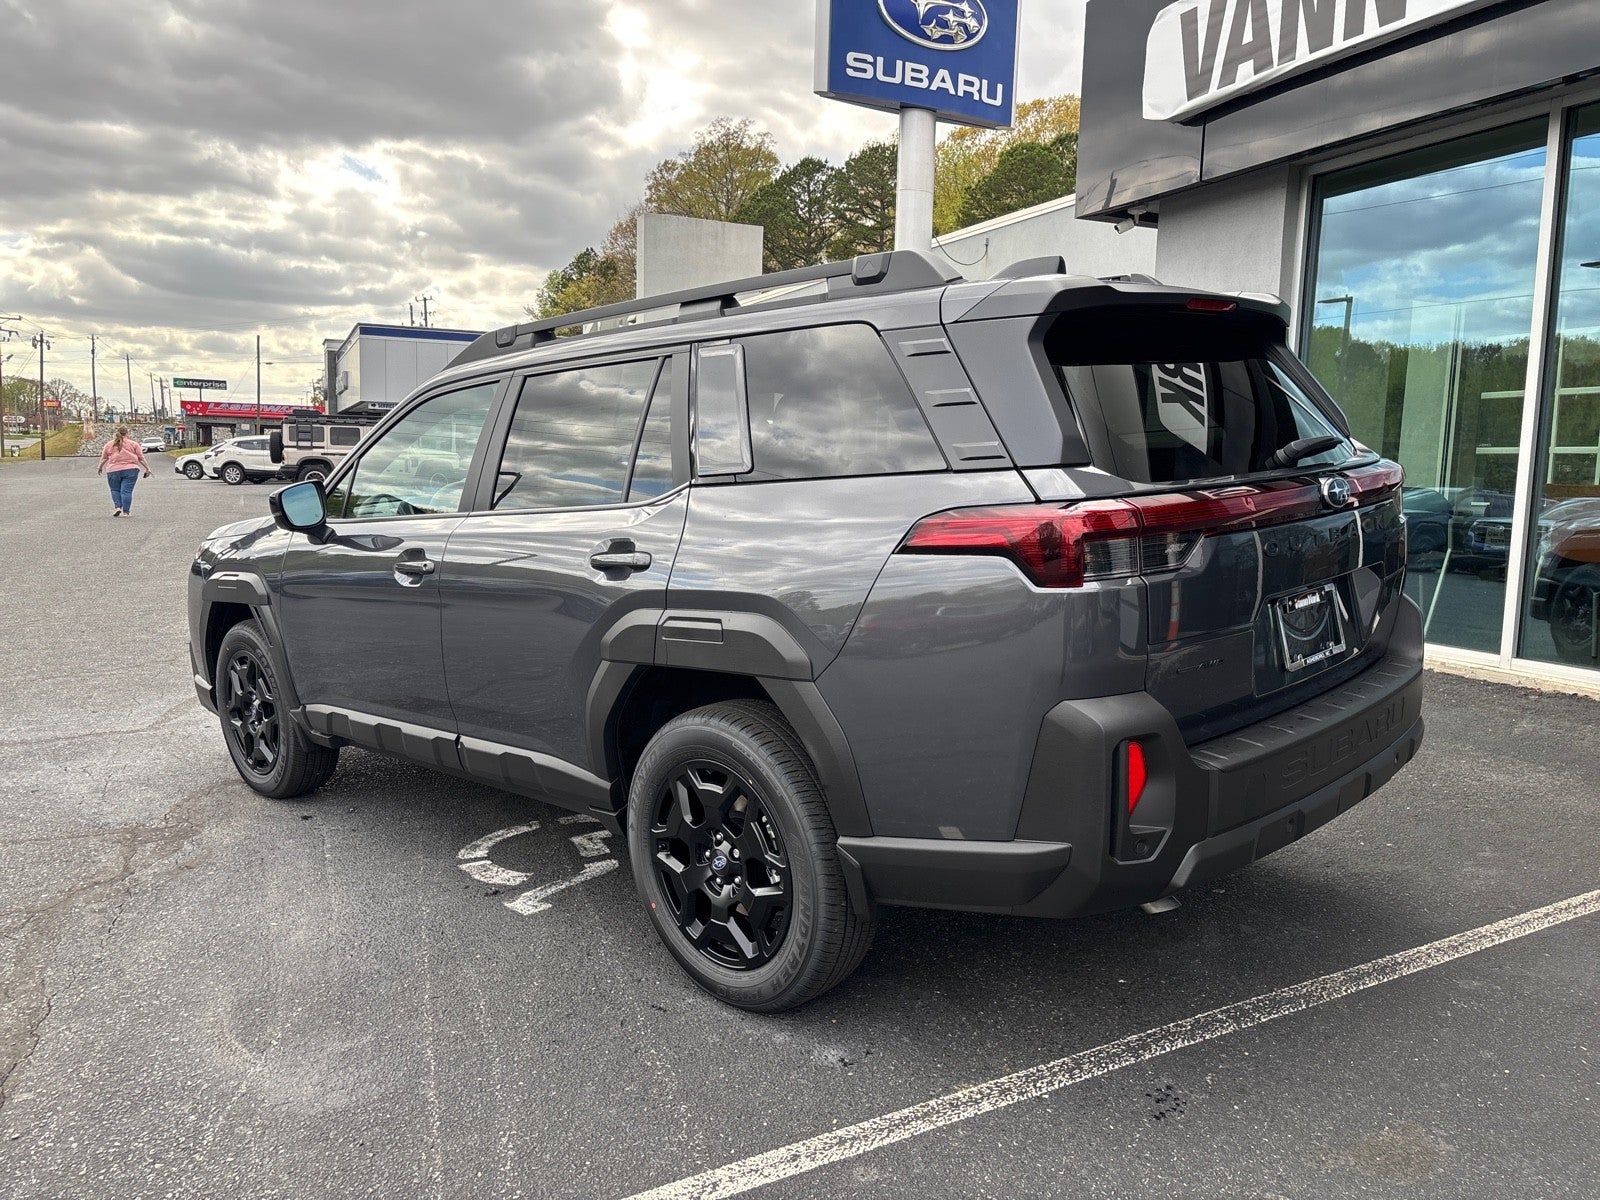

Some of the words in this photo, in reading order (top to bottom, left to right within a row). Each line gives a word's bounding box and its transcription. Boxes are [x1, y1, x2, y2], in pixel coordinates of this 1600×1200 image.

[845, 51, 1004, 107] SUBARU
[176, 380, 227, 389] enterprise
[1264, 514, 1384, 557] OUTBACK
[1282, 696, 1405, 790] SUBARU
